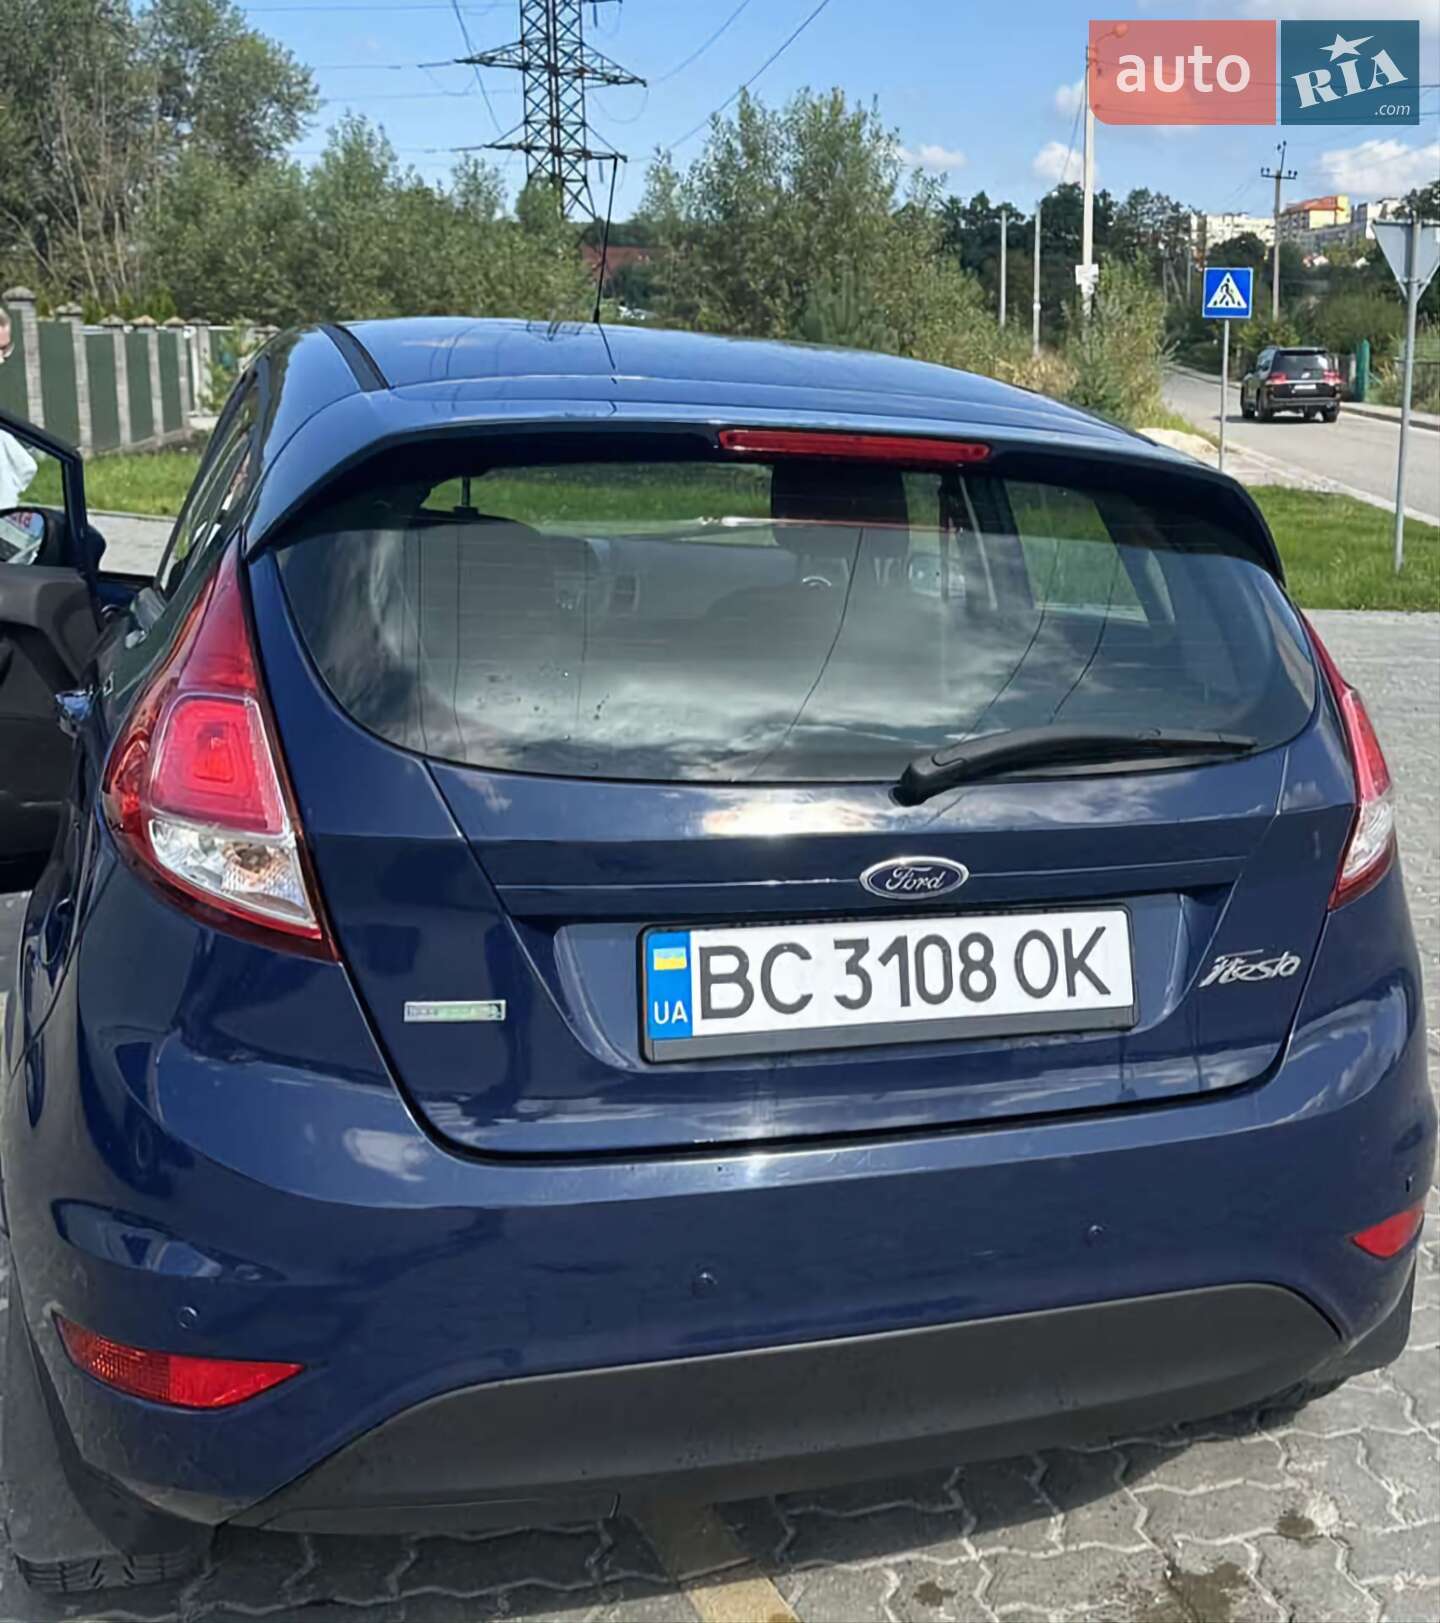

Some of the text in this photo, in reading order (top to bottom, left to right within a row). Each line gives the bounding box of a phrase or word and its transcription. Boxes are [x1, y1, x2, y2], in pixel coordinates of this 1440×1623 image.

[885, 866, 946, 891] Ford
[698, 926, 1112, 1020] BC 3108 OK
[653, 1001, 688, 1025] UA
